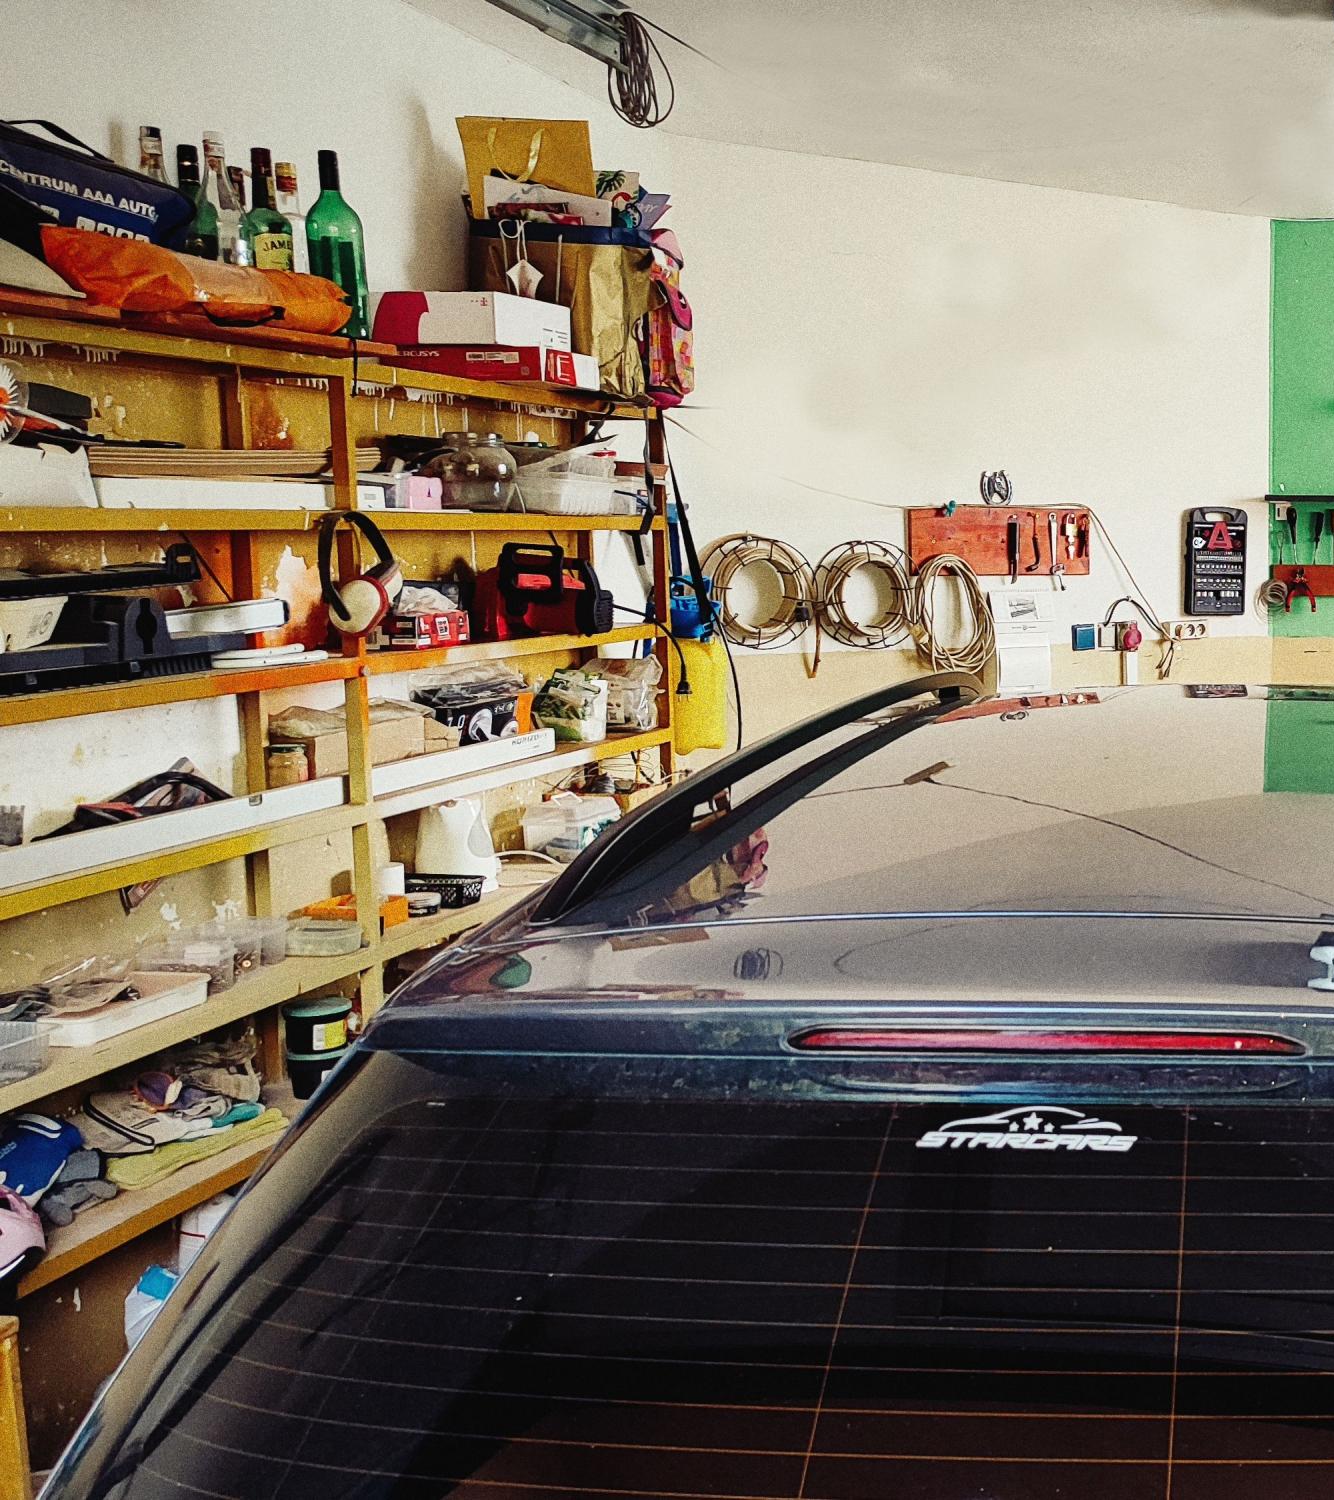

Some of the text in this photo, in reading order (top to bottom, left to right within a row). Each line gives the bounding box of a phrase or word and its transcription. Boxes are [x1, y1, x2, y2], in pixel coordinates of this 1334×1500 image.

[0, 159, 79, 196] CENTRUM
[83, 187, 115, 207] AAA
[915, 1131, 1138, 1152] STARCARS
